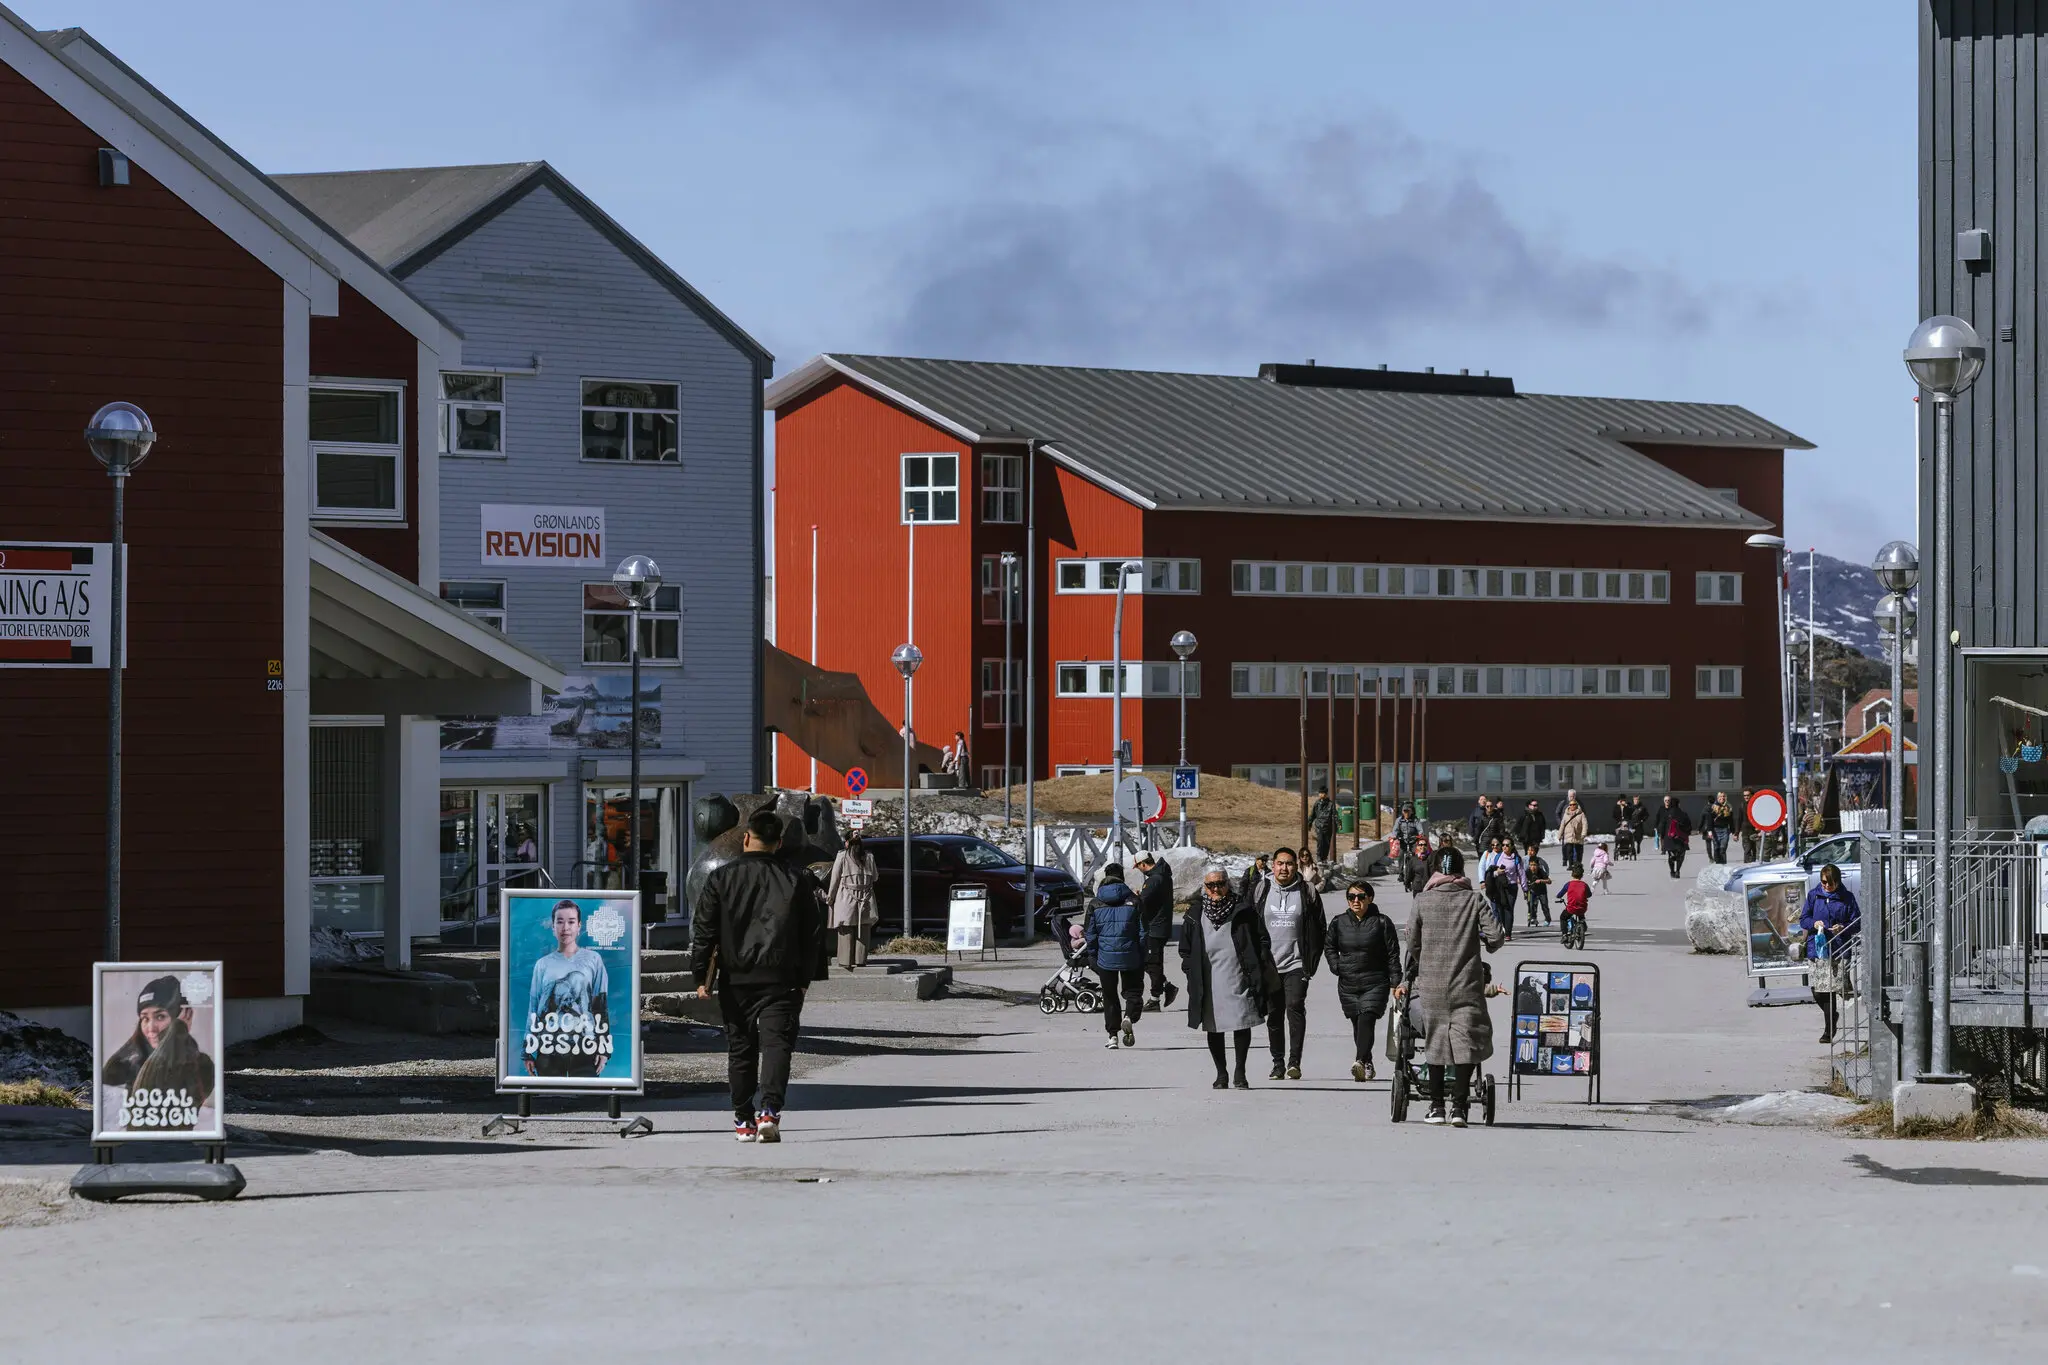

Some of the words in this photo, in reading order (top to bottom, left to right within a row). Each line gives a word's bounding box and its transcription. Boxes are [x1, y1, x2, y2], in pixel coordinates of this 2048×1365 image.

[533, 514, 600, 530] GRØNLANDS
[486, 530, 600, 558] REVISION
[54, 580, 90, 620] A/S
[0, 623, 90, 638] TORLEVERANDØR
[269, 662, 280, 673] 24
[1270, 919, 1296, 927] adidas
[530, 1012, 608, 1033] LOCAL
[525, 1033, 613, 1055] DESIGN
[122, 1088, 193, 1108] LOCAL
[118, 1107, 198, 1127] DESIGN
